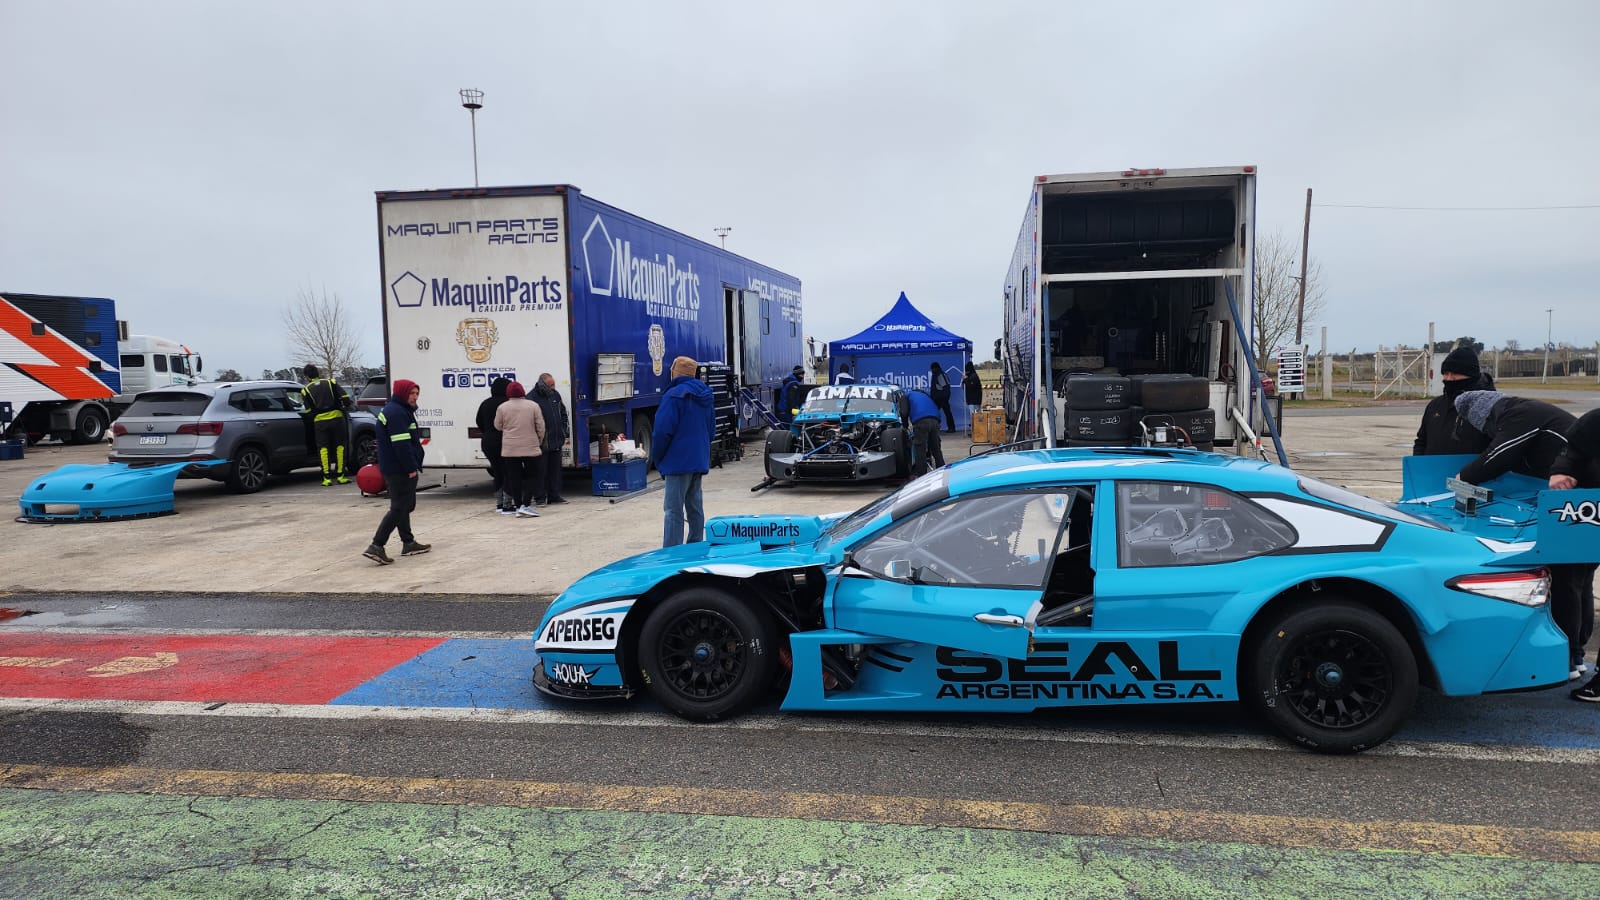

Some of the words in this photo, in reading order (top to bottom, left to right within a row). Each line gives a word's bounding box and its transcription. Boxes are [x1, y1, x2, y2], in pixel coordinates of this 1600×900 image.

[387, 221, 472, 237] MAQUIN
[476, 217, 559, 233] PARTS
[488, 233, 558, 245] RACING
[615, 238, 700, 315] MaquinParts
[431, 275, 562, 313] MaquinParts
[478, 304, 516, 313] CALIDAD
[519, 303, 562, 311] PREMIUM
[650, 303, 674, 317] CALIDAD
[674, 307, 698, 322] PREMIUM
[417, 340, 430, 350] 80
[841, 342, 880, 350] MAQUIN
[1550, 501, 1600, 525] AQ
[731, 522, 800, 540] MaquinParts
[546, 617, 615, 643] APERSEG
[936, 641, 1222, 682] SEAL
[552, 663, 598, 685] AQUA
[935, 683, 1146, 699] ARGENTINA
[1153, 683, 1223, 699] S.A.
